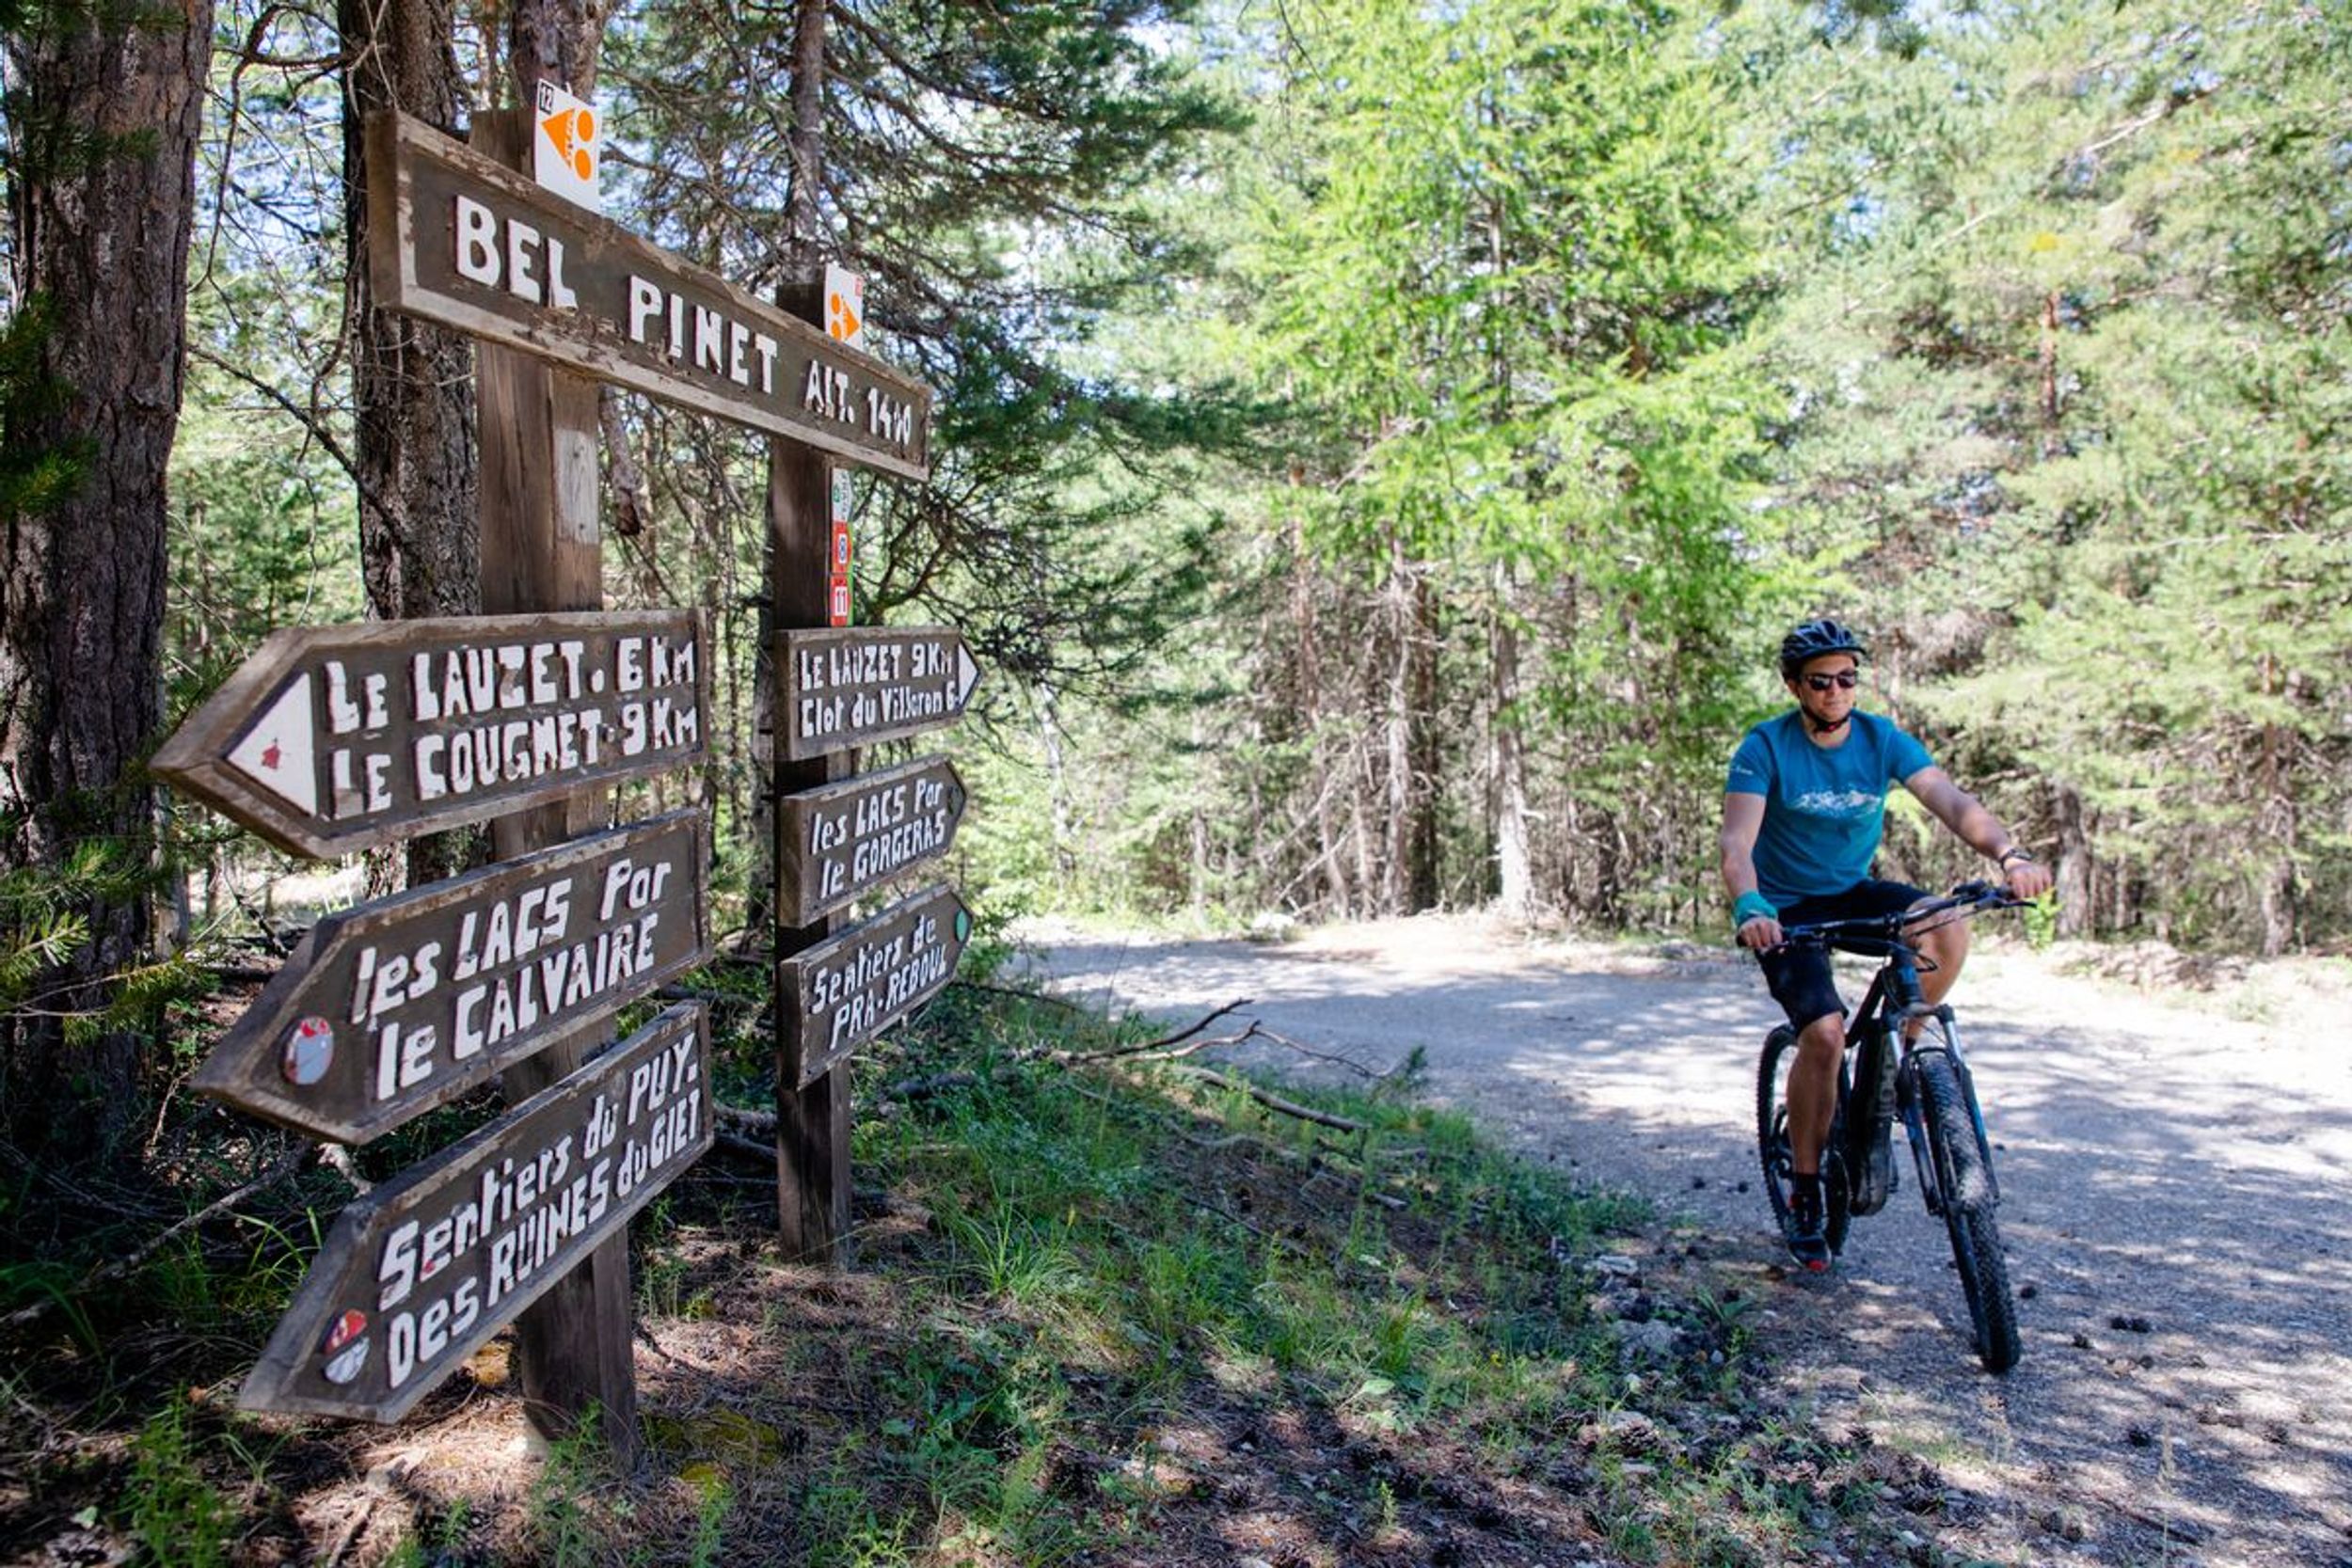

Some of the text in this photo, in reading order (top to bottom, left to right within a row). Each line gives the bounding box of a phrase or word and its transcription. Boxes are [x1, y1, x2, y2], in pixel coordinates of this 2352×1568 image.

[457, 195, 579, 312] BEL
[630, 275, 777, 394] PINET
[803, 694, 844, 737] Clot
[851, 691, 876, 728] du
[830, 643, 901, 687] LAUZET
[333, 749, 392, 819] LE
[812, 812, 847, 855] les
[855, 784, 906, 838] LACS
[821, 809, 946, 899] le GORGERAS
[351, 858, 672, 1024] les LACS Par
[813, 913, 937, 1014] Sentiers de
[377, 912, 659, 1101] le CALVAIRE
[378, 1135, 573, 1312] Sentiers
[584, 1095, 620, 1160] du
[487, 1157, 612, 1307] RUINES
[617, 1139, 648, 1196] du
